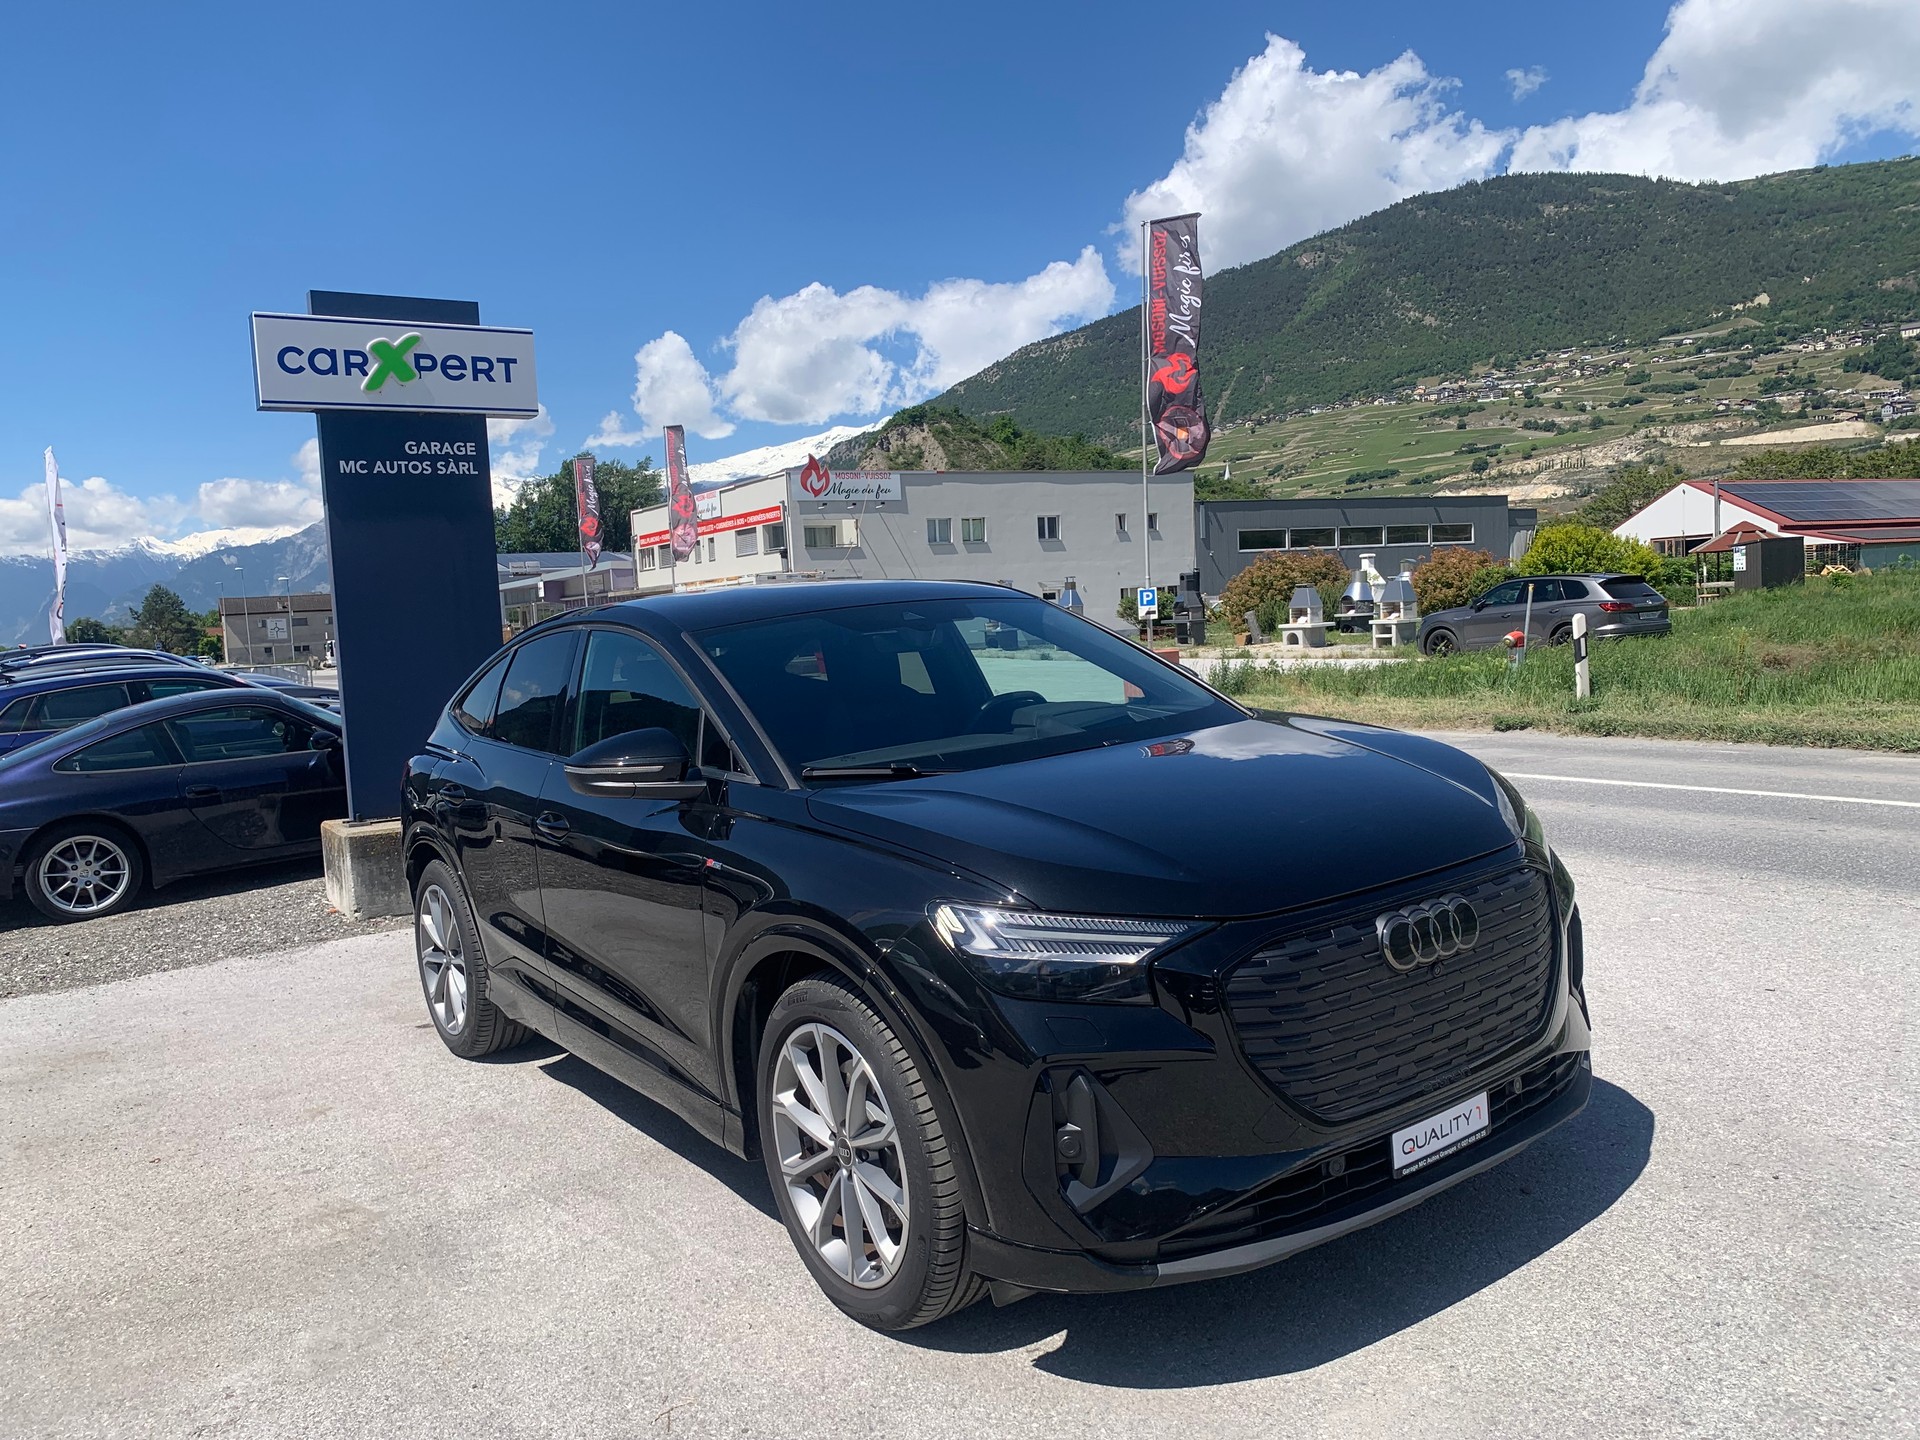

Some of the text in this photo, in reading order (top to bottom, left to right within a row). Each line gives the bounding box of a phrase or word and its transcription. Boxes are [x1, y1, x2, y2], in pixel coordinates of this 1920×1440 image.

[1152, 231, 1168, 353] MOSONI-VUISSOZ
[1169, 278, 1201, 348] Magic
[404, 441, 477, 456] GARAGE
[339, 457, 479, 475] MC AUTOS SÀRL
[835, 472, 892, 480] MOSONI-VUISSOZ
[824, 481, 892, 499] Magie du feu
[1143, 592, 1153, 605] P
[1402, 1109, 1473, 1155] QUALITY
